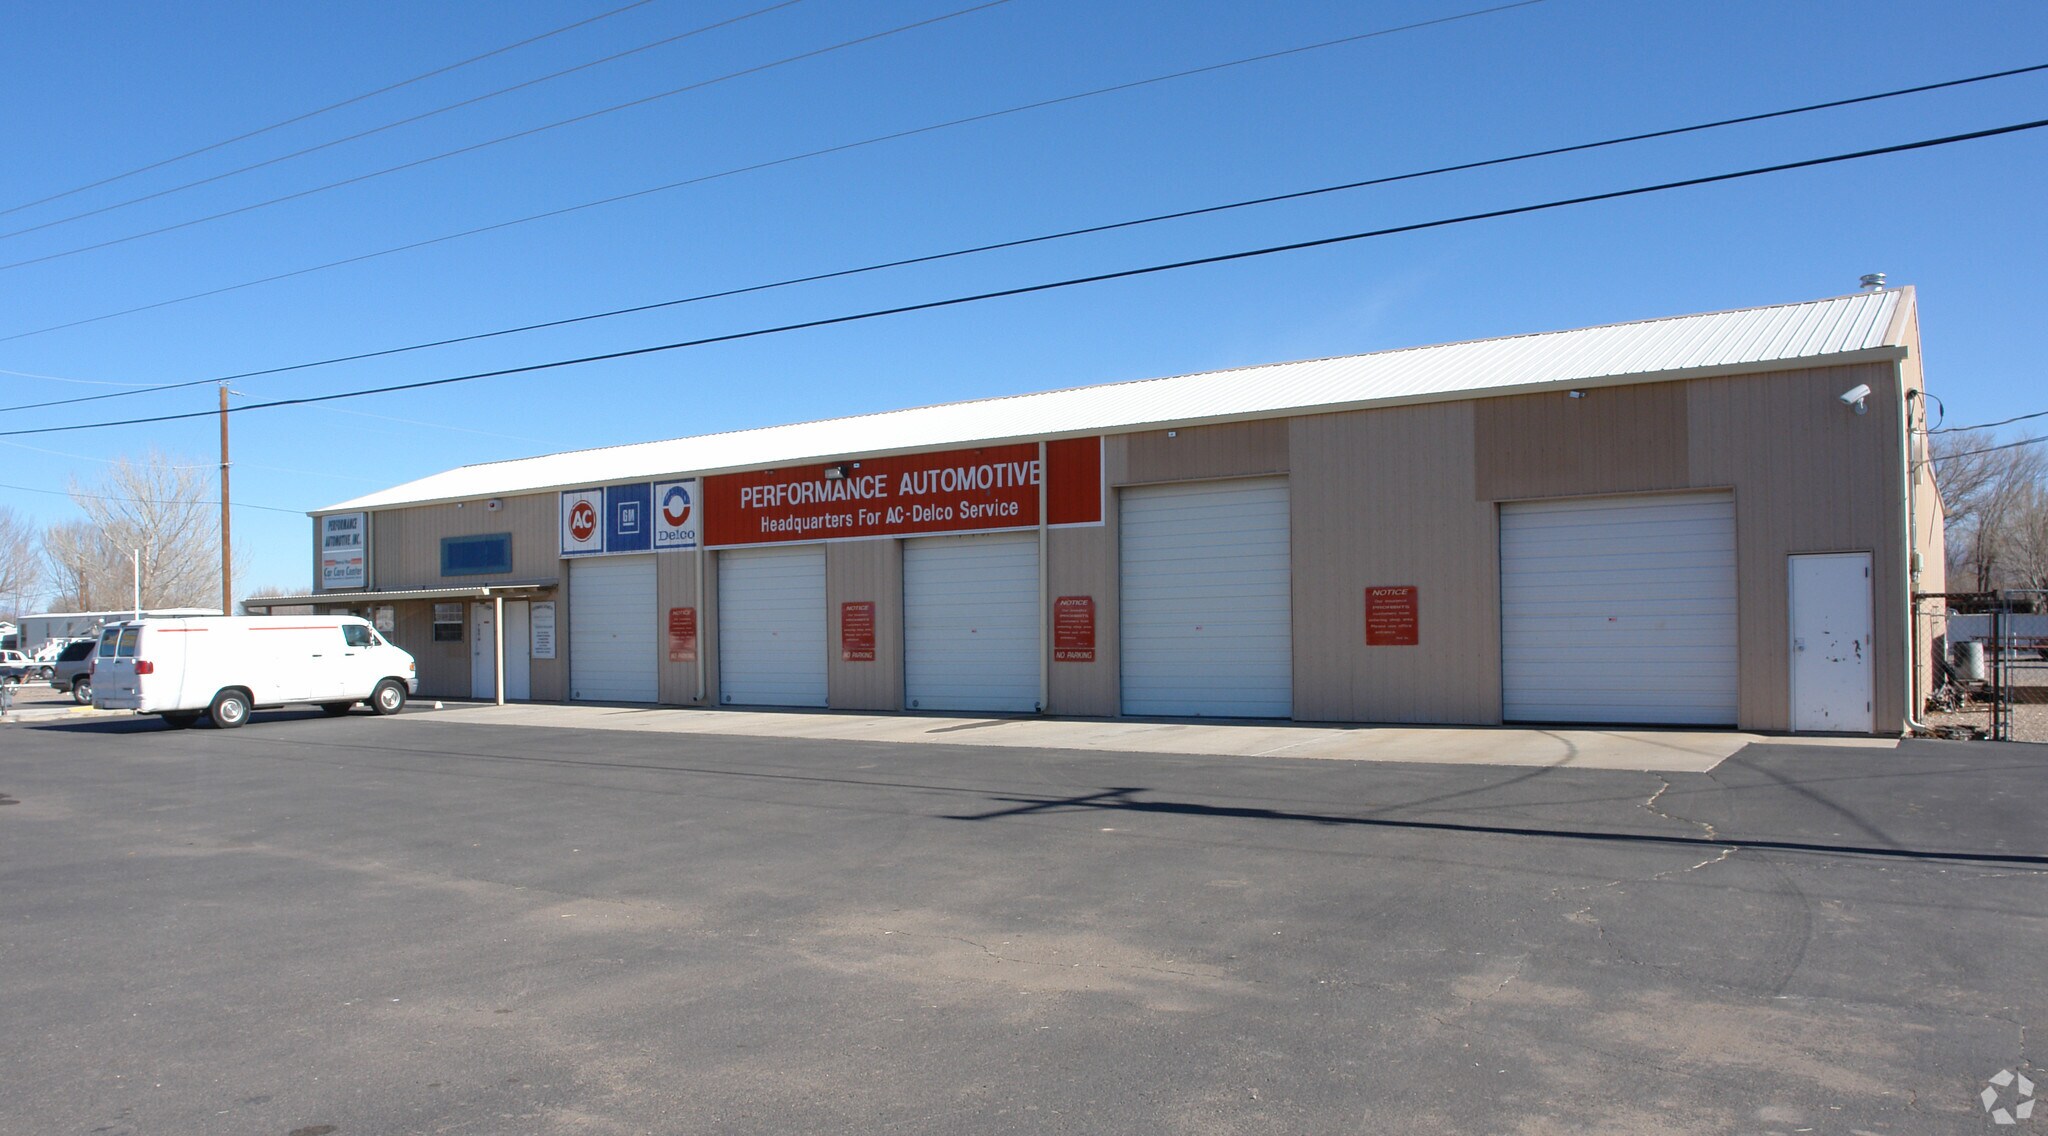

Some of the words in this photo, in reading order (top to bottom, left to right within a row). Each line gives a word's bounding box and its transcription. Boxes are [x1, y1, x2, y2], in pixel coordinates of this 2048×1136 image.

[741, 474, 888, 509] PERFORMANCE
[899, 460, 1041, 496] AUTOMOTIVE
[572, 510, 592, 530] AC
[622, 508, 635, 523] GM
[761, 513, 853, 534] Headquarters
[858, 508, 882, 526] For
[885, 504, 953, 524] AC-Delco
[959, 498, 1019, 519] Service
[658, 530, 695, 541] Delco
[1372, 588, 1409, 596] NOTICE
[852, 651, 873, 659] PARKING
[1056, 651, 1065, 659] NO
[1067, 651, 1092, 659] PARKING
